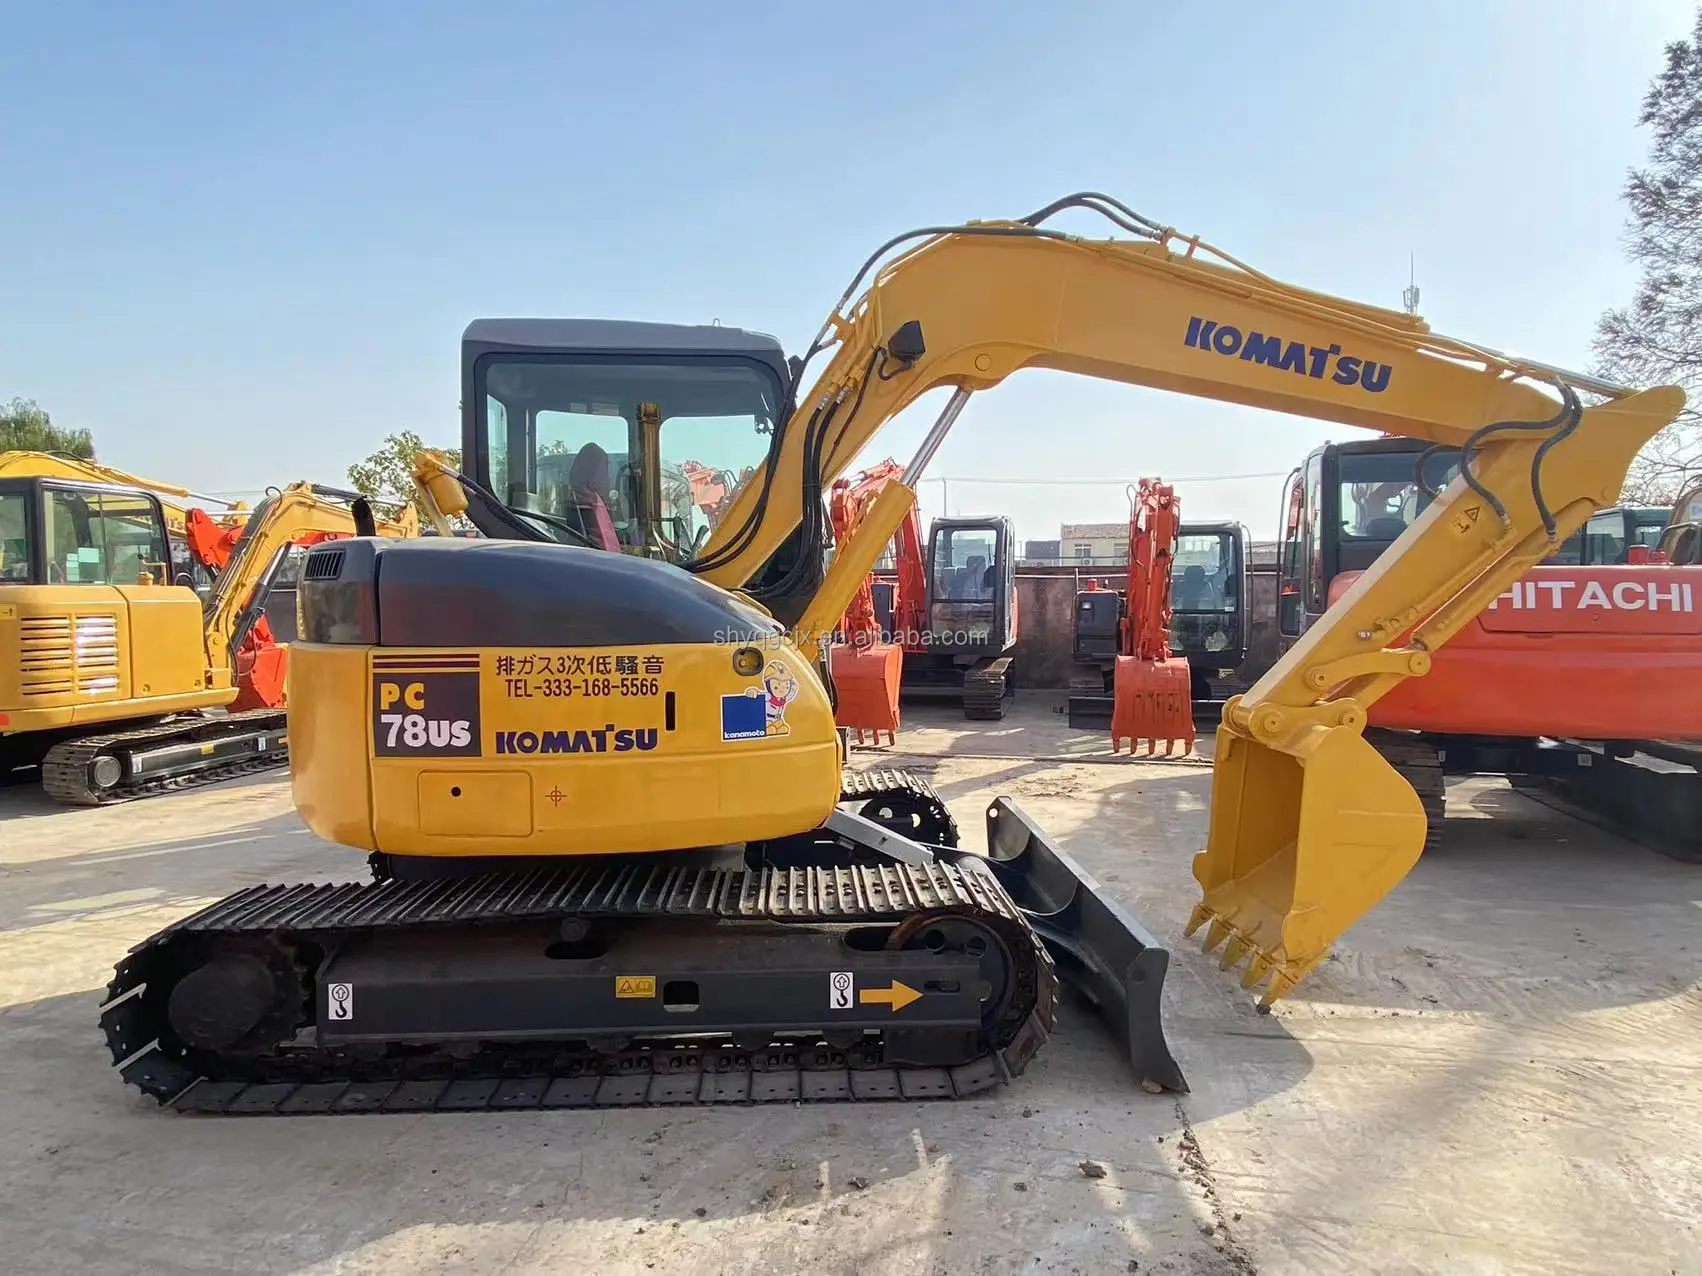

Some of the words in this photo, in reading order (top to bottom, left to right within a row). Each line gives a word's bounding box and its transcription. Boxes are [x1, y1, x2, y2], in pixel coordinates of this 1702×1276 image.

[1184, 316, 1393, 393] KOMATSU
[496, 654, 665, 675] 排ガス3次低騒音
[380, 682, 425, 710] PC
[505, 677, 659, 697] TEL-333-168-5566
[496, 723, 658, 754] KOMATSU
[724, 729, 766, 739] kanamoto
